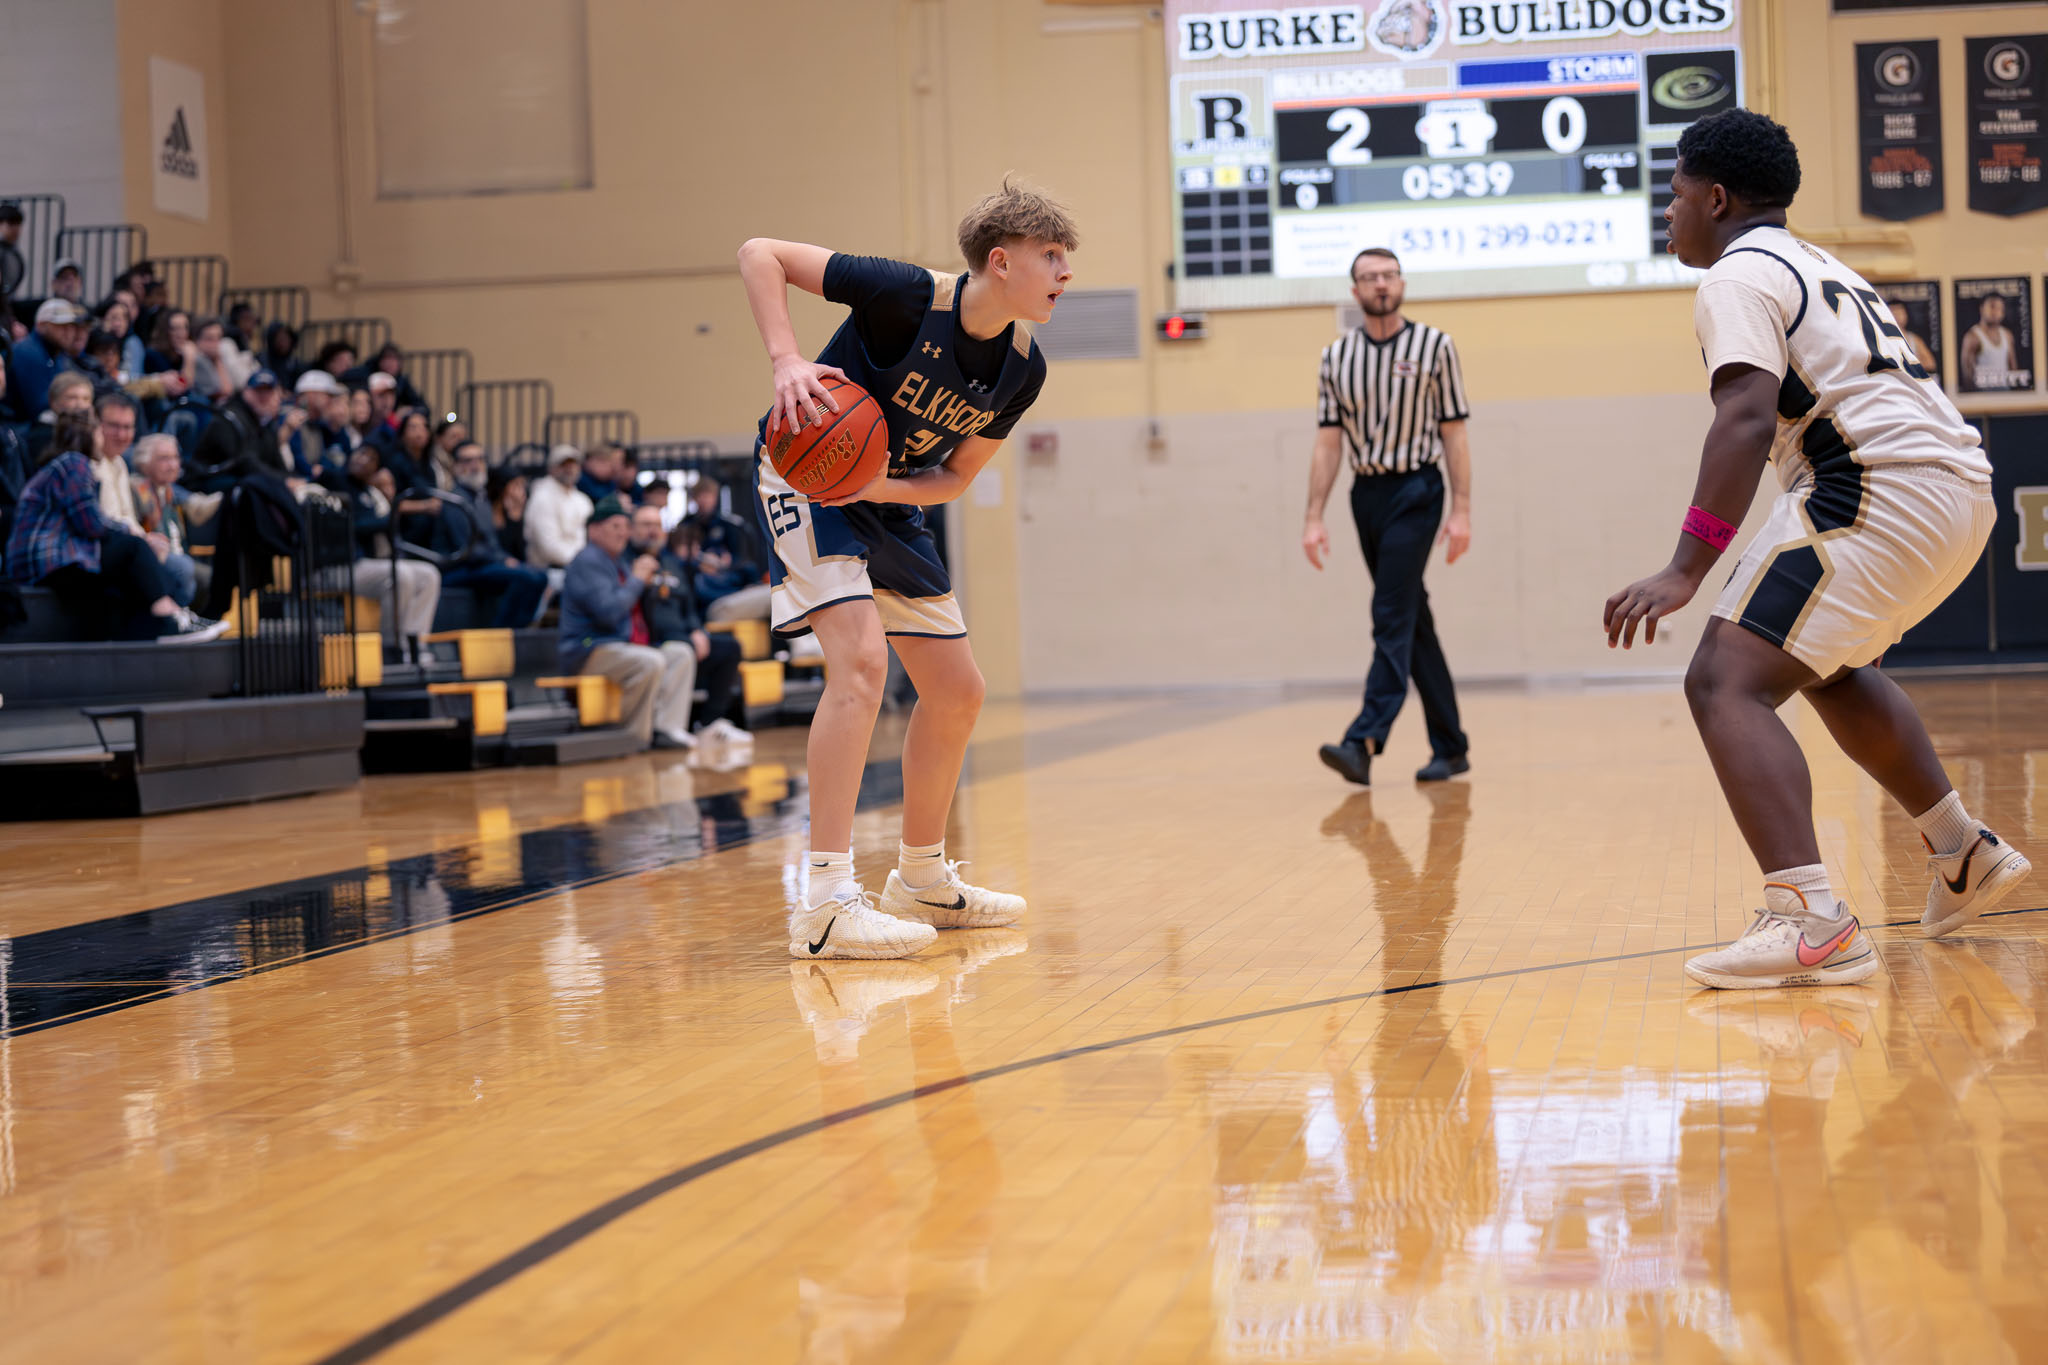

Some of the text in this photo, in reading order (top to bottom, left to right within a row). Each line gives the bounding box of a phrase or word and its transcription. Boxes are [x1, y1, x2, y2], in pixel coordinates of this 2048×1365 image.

[1187, 0, 1726, 51] BURKE BULLDOGS
[1547, 55, 1636, 83] STORM
[1326, 106, 1373, 166] 2
[1447, 120, 1466, 149] 1
[1541, 95, 1588, 154] 0
[1280, 167, 1334, 185] FOULS
[1583, 152, 1637, 169] FOULS
[1296, 182, 1319, 210] 0
[1402, 161, 1514, 201] 05:39
[1601, 168, 1624, 195] 1
[1477, 219, 1615, 249] 299-0221
[1819, 279, 1933, 381] 25
[799, 427, 858, 489] Baden
[767, 491, 802, 538] ES
